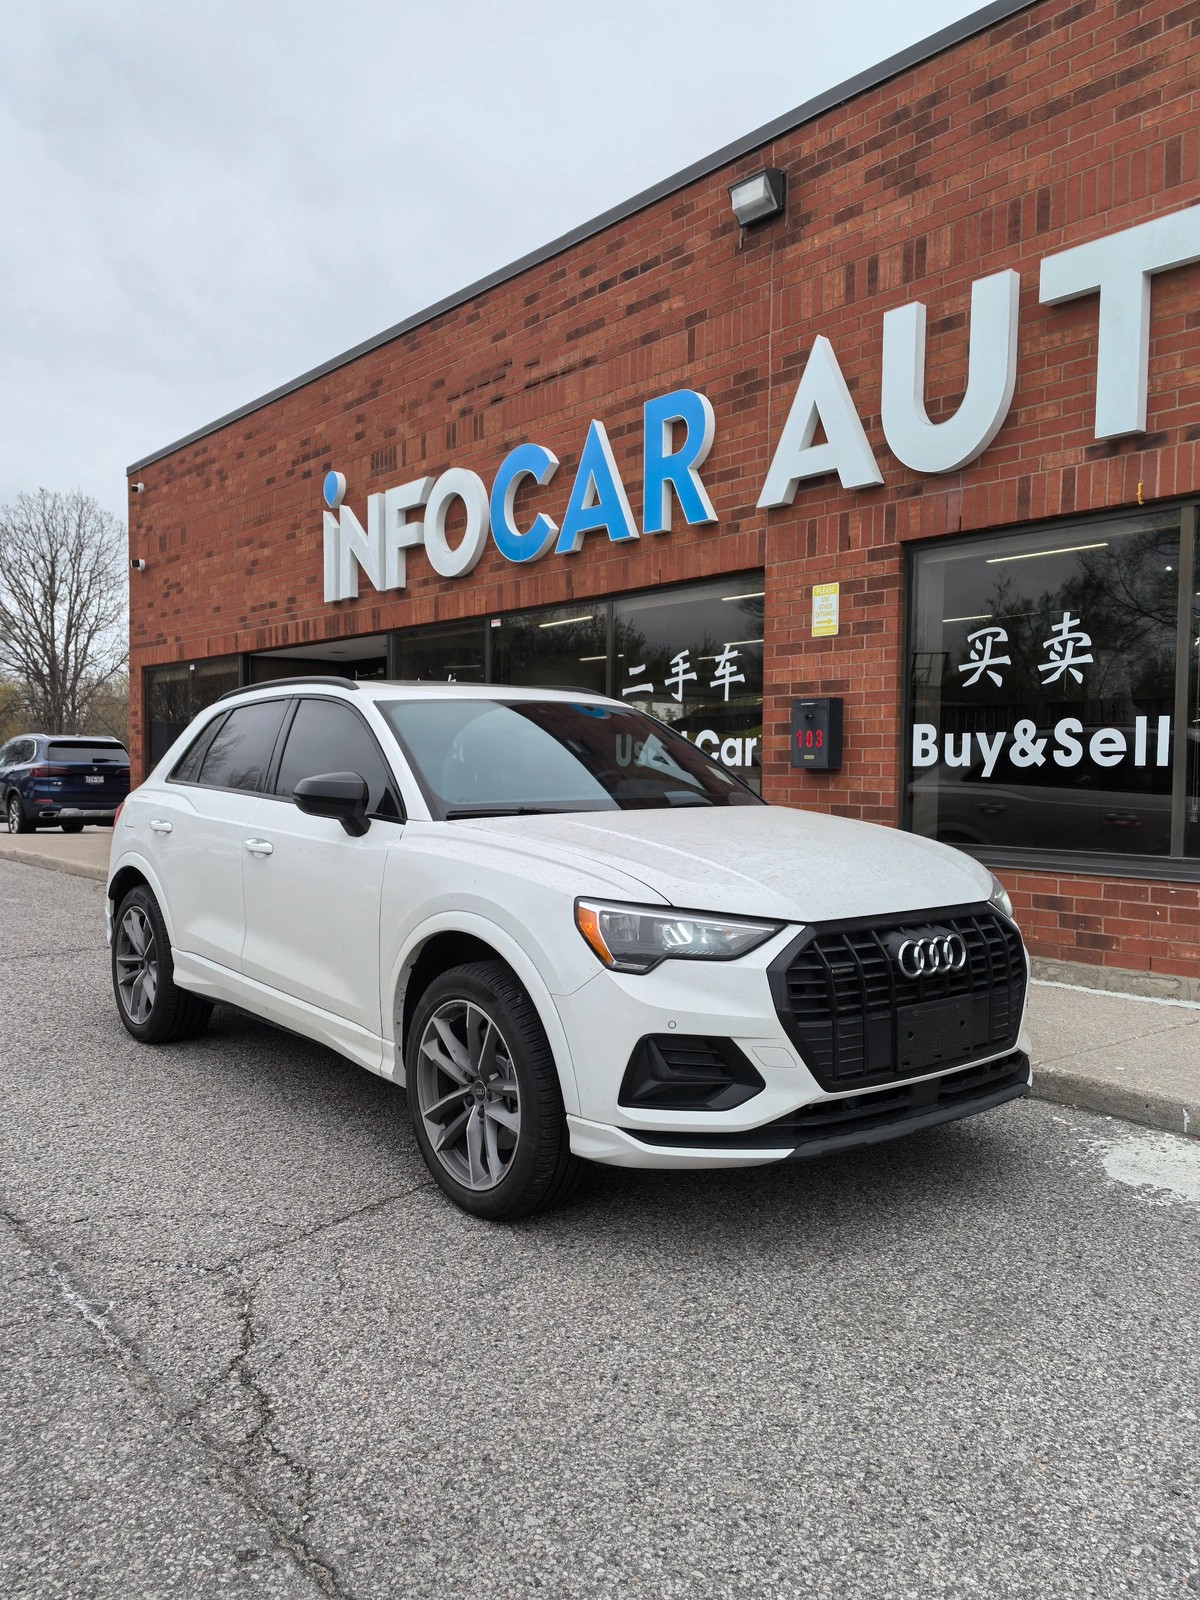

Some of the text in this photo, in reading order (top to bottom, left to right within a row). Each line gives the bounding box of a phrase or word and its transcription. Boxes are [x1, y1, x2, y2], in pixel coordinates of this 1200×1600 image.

[756, 204, 1200, 509] AUT
[815, 610, 836, 618] ENTRANCE
[816, 585, 835, 595] PLEASE
[622, 643, 746, 702] 二手车
[958, 611, 1094, 688] 买卖
[796, 729, 823, 749] 103
[912, 715, 1171, 778] Buy&Sell
